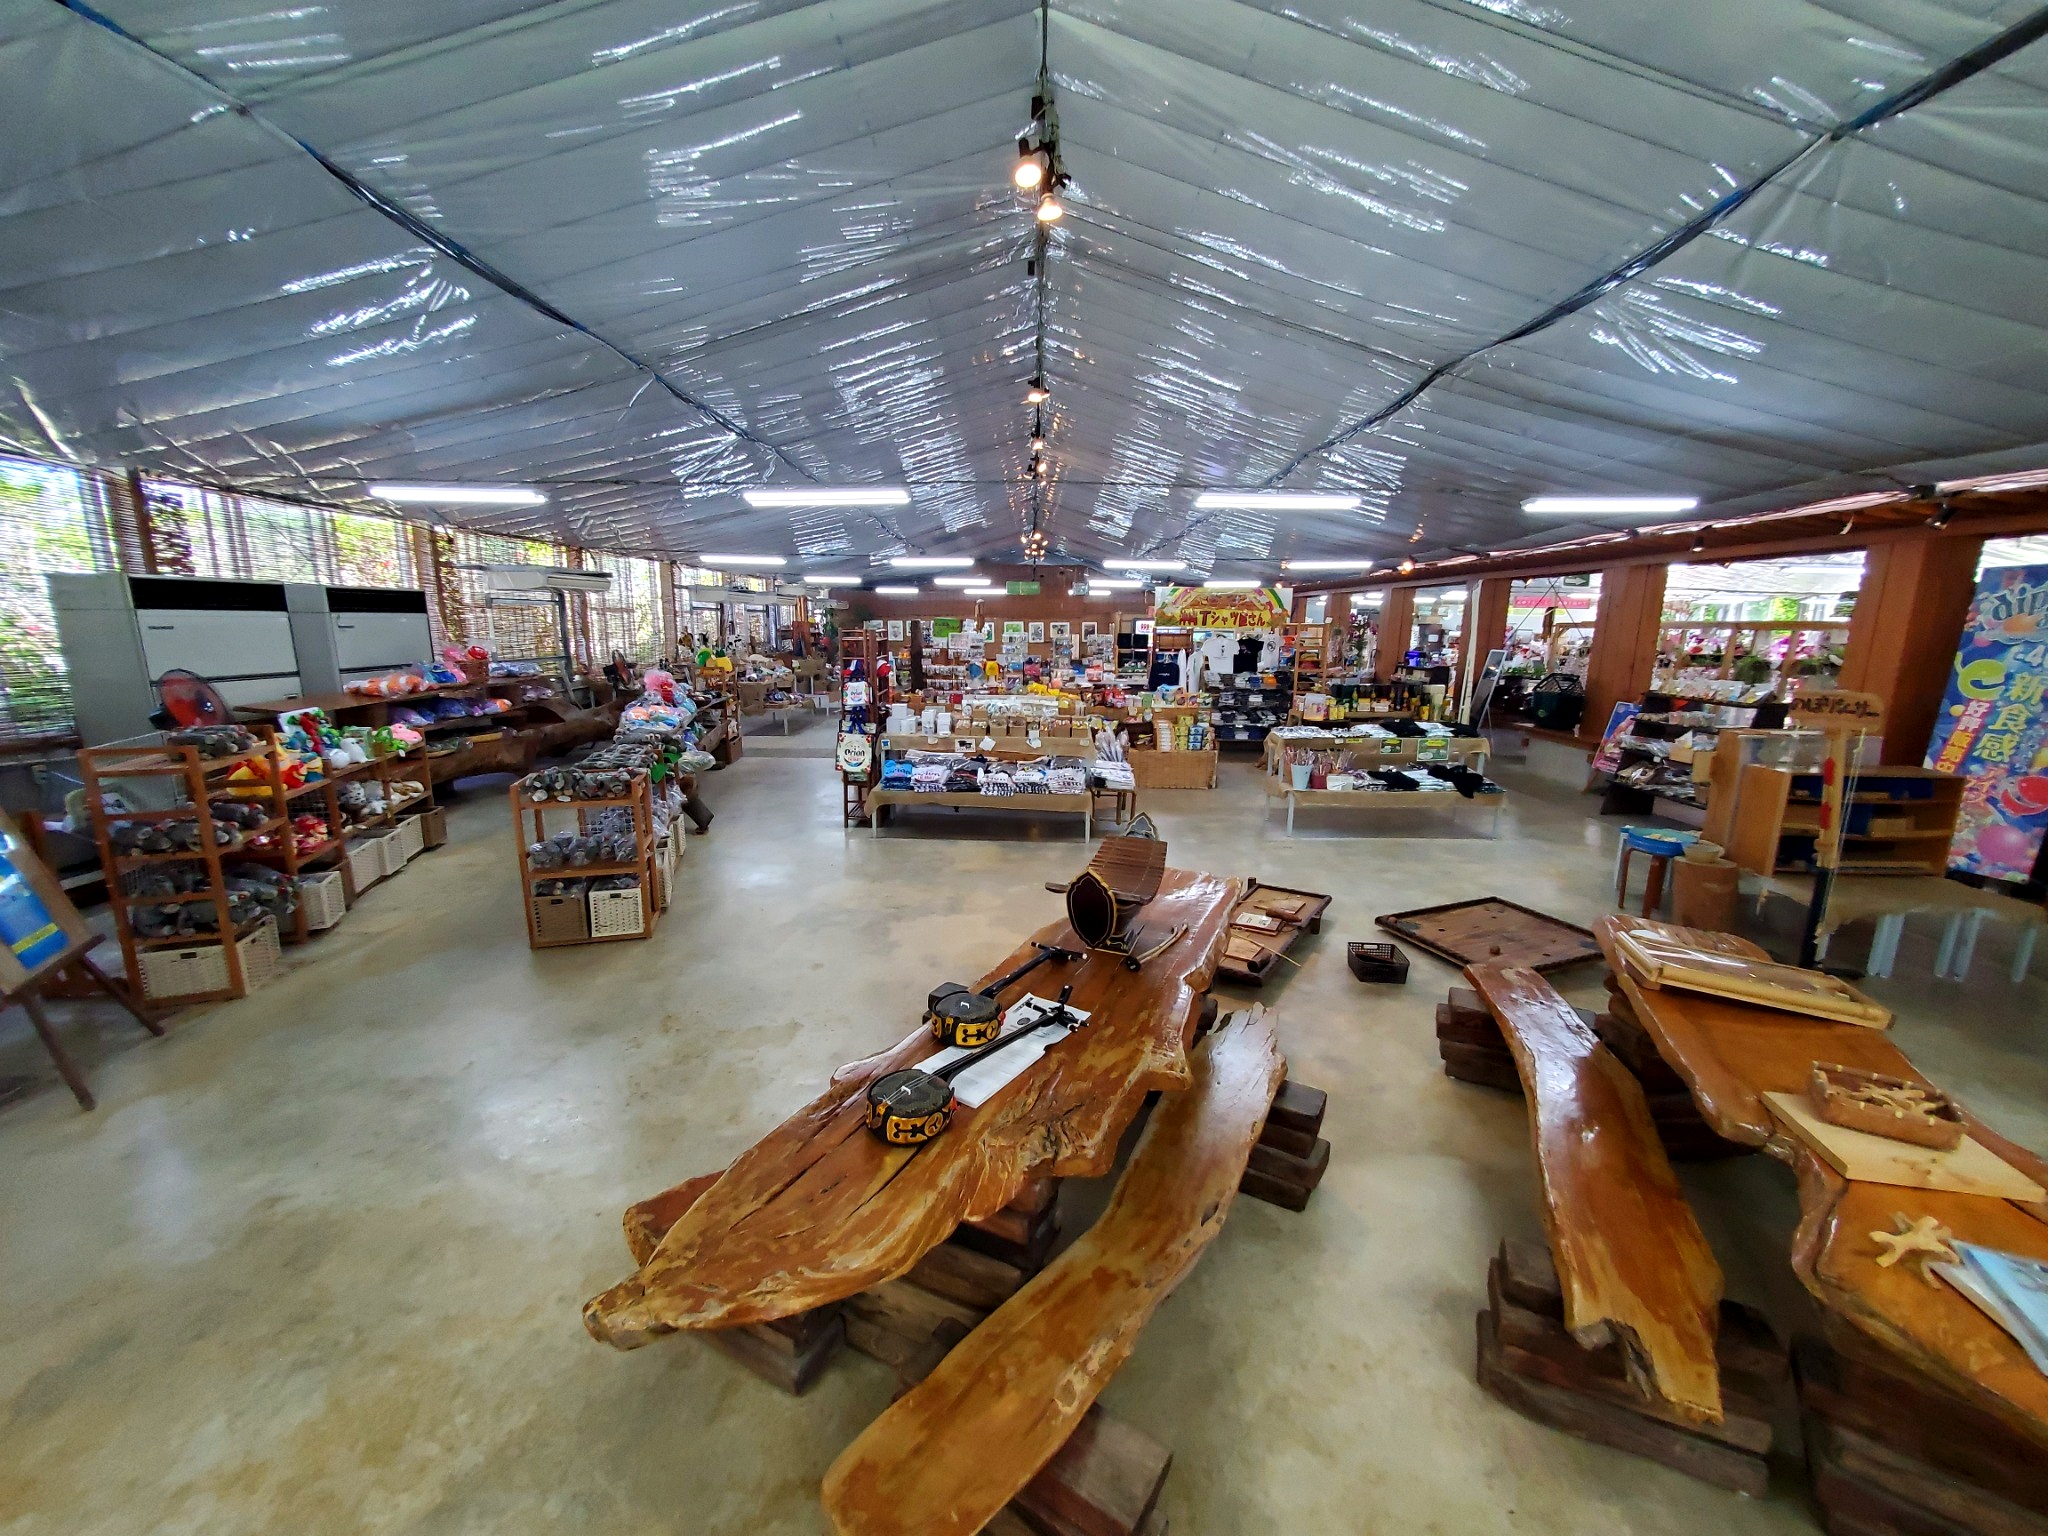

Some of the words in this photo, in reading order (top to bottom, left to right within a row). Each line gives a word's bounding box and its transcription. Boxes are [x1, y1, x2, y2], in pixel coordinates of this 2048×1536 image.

[1936, 700, 1991, 773] 好評販売中
[1972, 672, 2047, 763] 新食感
